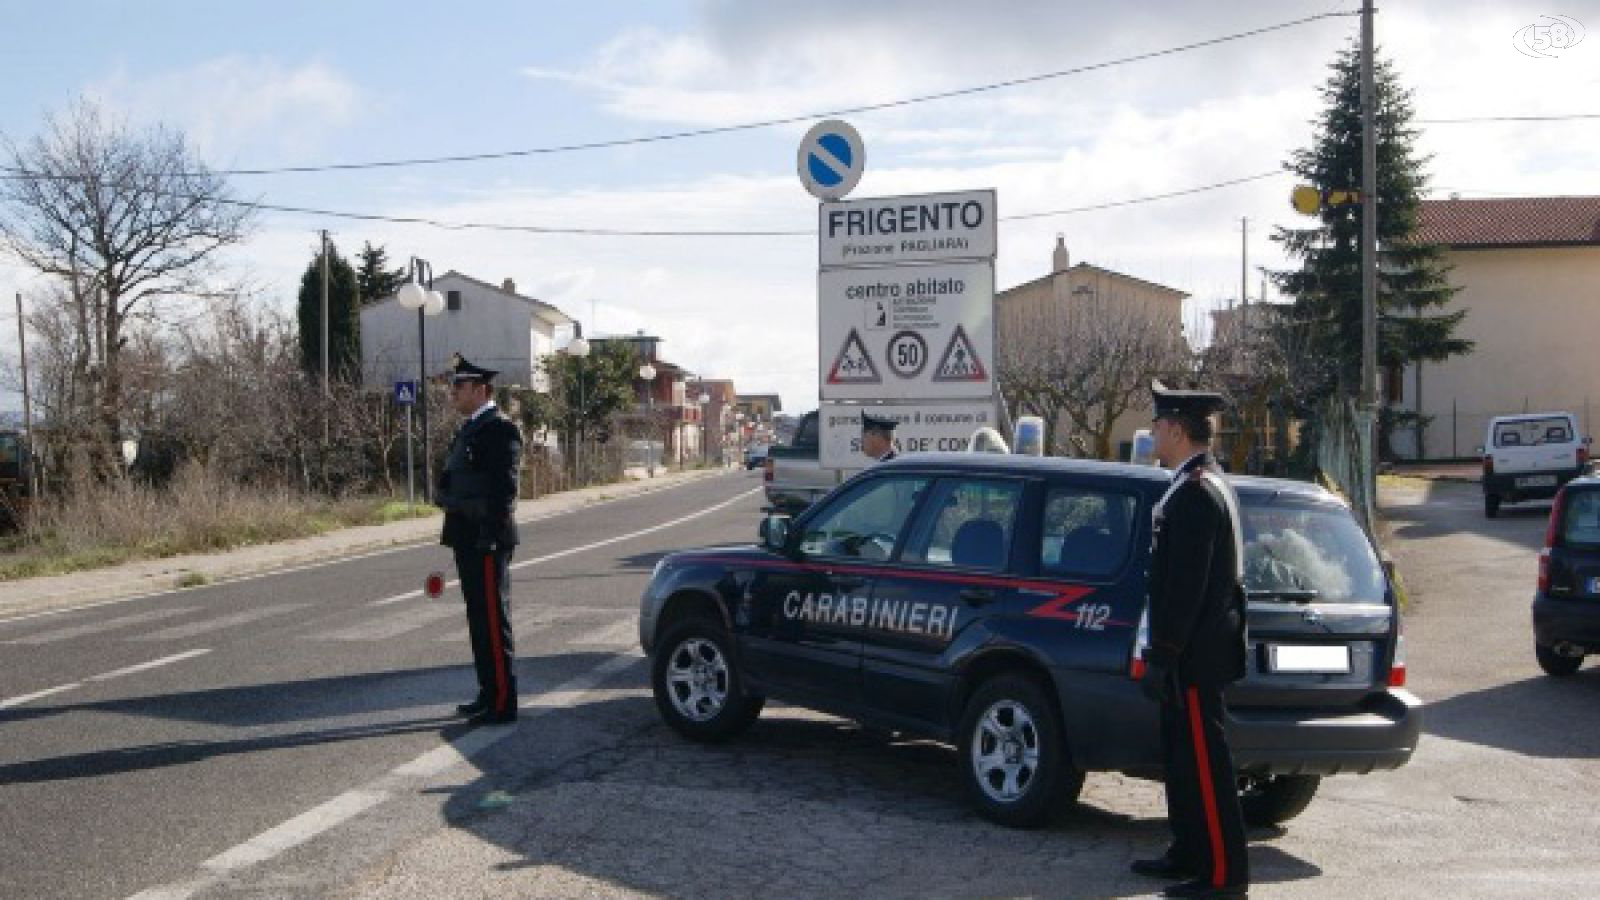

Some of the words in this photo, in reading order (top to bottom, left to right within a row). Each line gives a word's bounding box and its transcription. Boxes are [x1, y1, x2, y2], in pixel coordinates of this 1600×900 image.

[828, 200, 984, 238] FRIGENTO
[846, 281, 900, 300] centro
[906, 277, 966, 295] abitato
[898, 344, 919, 367] 50
[784, 590, 959, 641] CARABINIERI
[1074, 603, 1112, 631] 112
